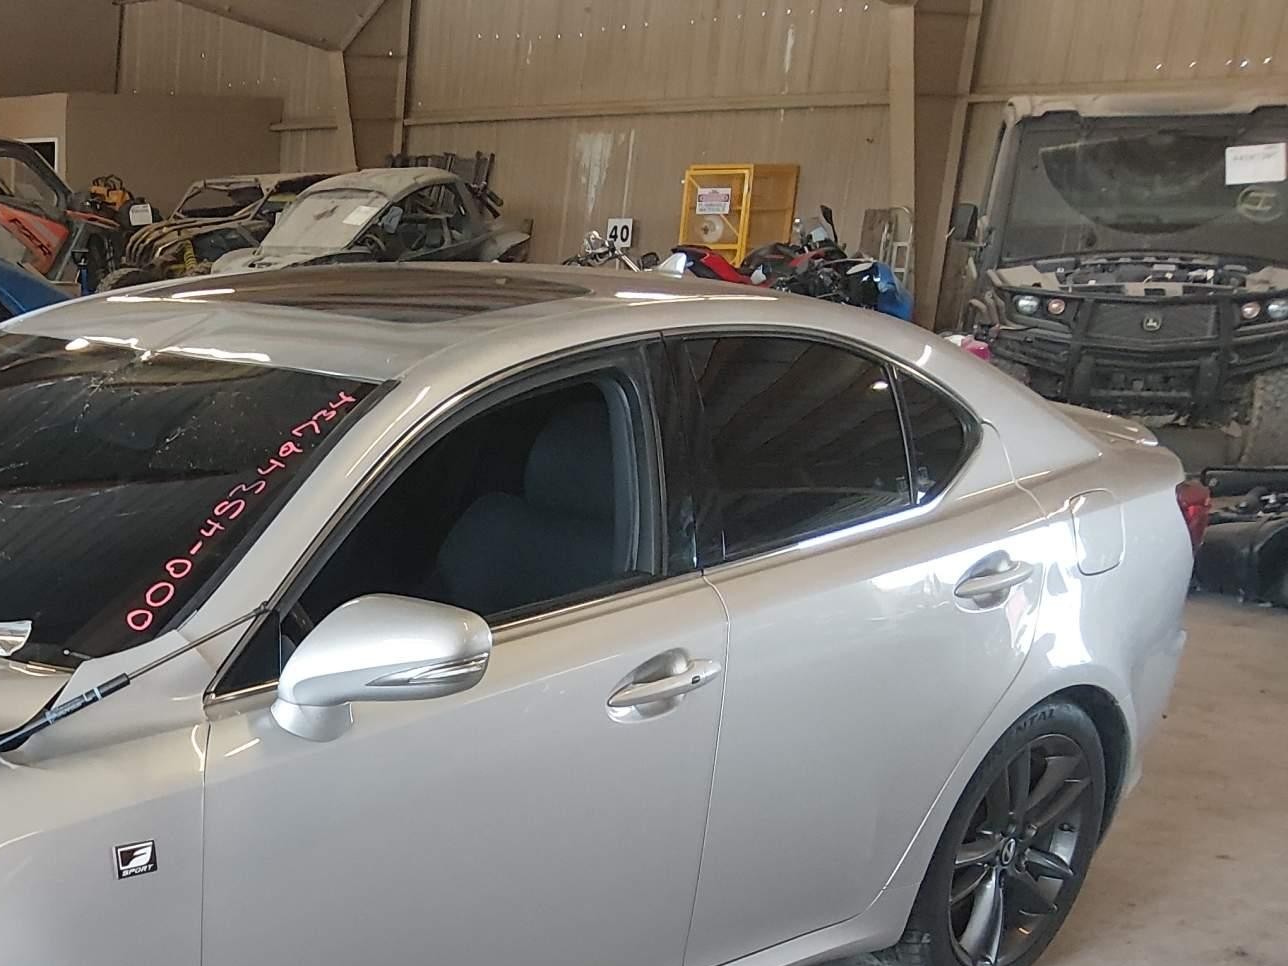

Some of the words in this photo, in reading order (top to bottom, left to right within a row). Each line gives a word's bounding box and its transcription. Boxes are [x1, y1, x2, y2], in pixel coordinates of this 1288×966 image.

[609, 224, 629, 242] 40
[126, 391, 356, 631] 000-45349734
[122, 863, 154, 877] SPORT
